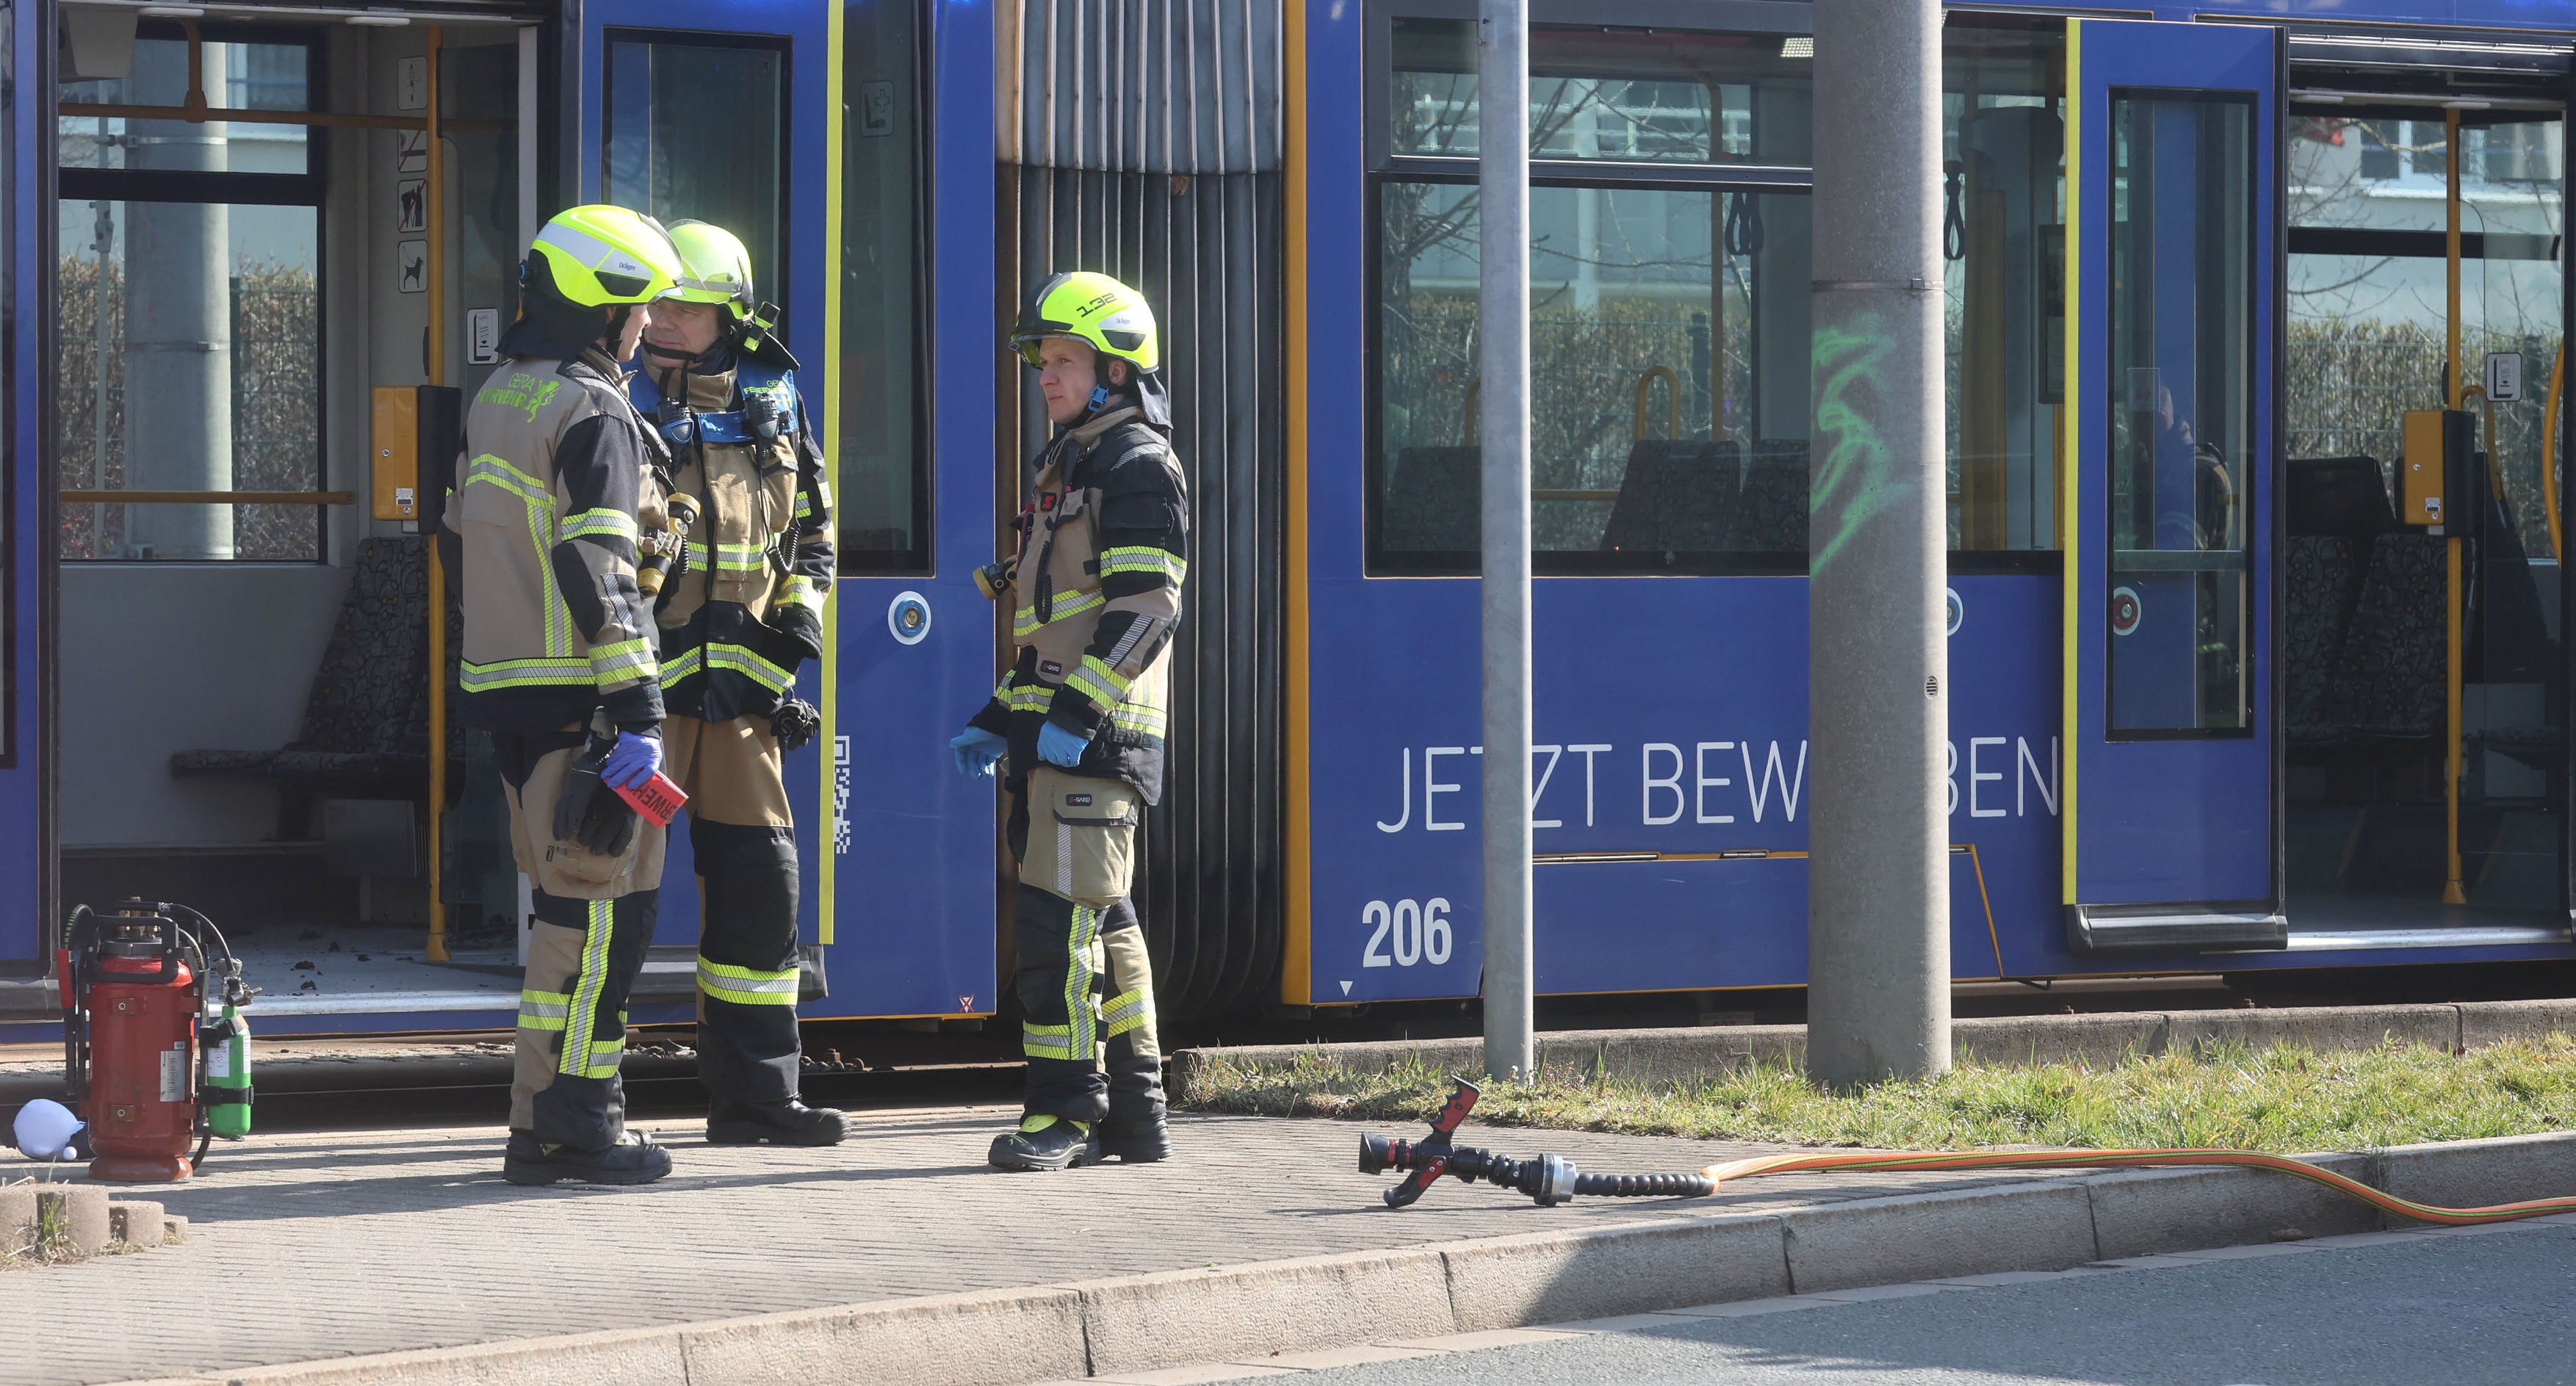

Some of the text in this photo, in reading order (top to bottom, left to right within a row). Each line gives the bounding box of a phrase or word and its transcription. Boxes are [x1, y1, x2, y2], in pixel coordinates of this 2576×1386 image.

[618, 261, 636, 271] Dräger
[1076, 293, 1117, 317] 132
[508, 372, 536, 392] GERA
[743, 386, 790, 394] FEUERWE
[1377, 736, 2057, 833] JEZT BEWEN
[1363, 898, 1452, 967] 206
